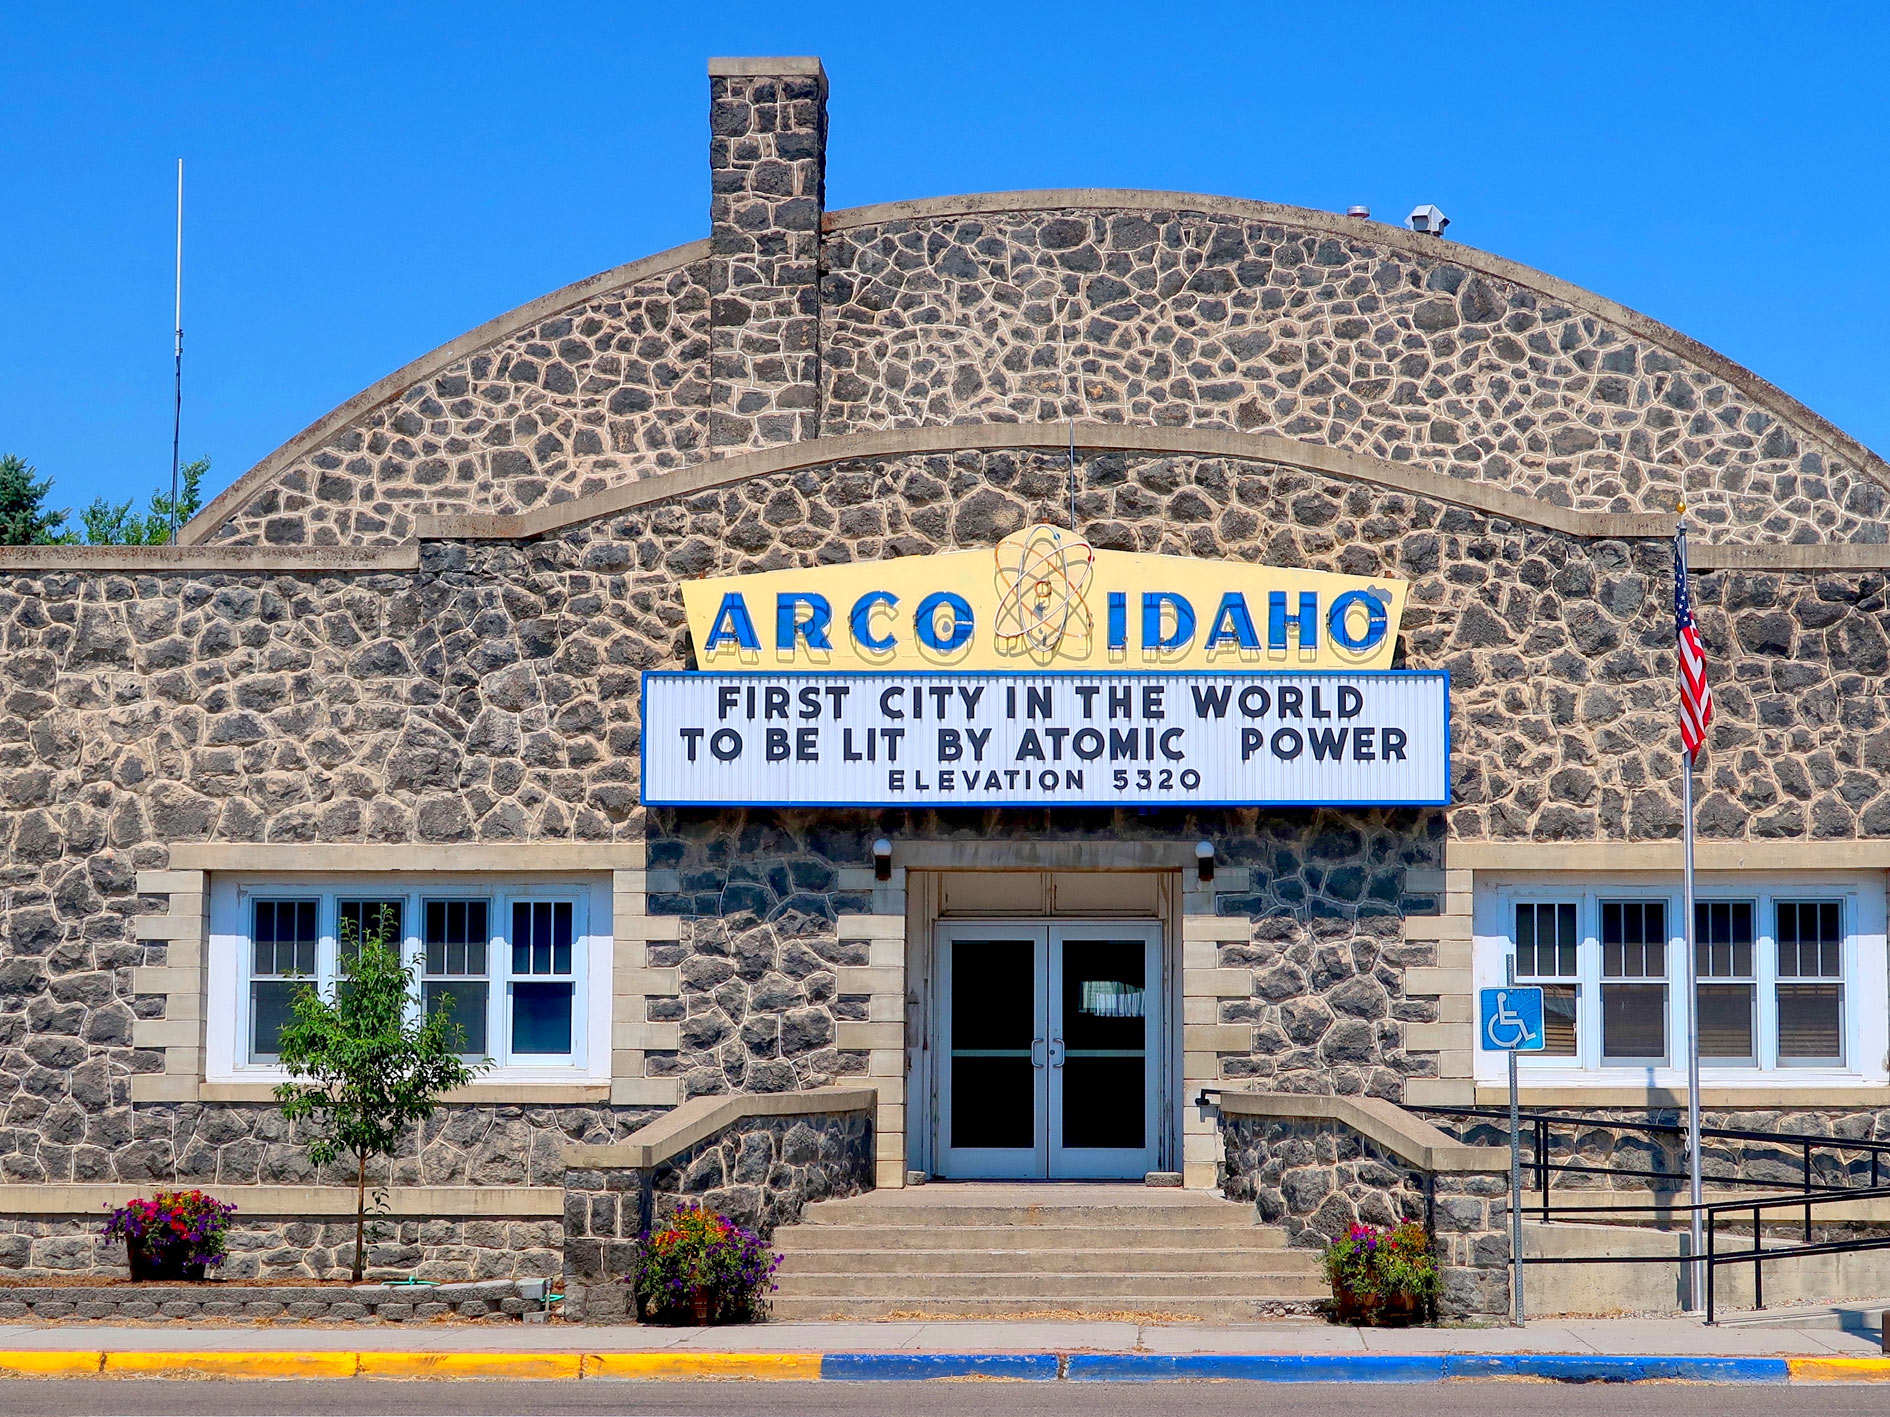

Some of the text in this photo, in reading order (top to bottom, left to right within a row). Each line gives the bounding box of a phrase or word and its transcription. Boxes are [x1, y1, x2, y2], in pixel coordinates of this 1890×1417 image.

[704, 590, 1388, 651] ARCO IDAHO
[718, 685, 1364, 720] FIRST CITY IN THE WORLD
[679, 727, 1408, 762] TO BE LIT BY ATOMIC POWER
[888, 768, 1201, 791] ELEVATION 5320
